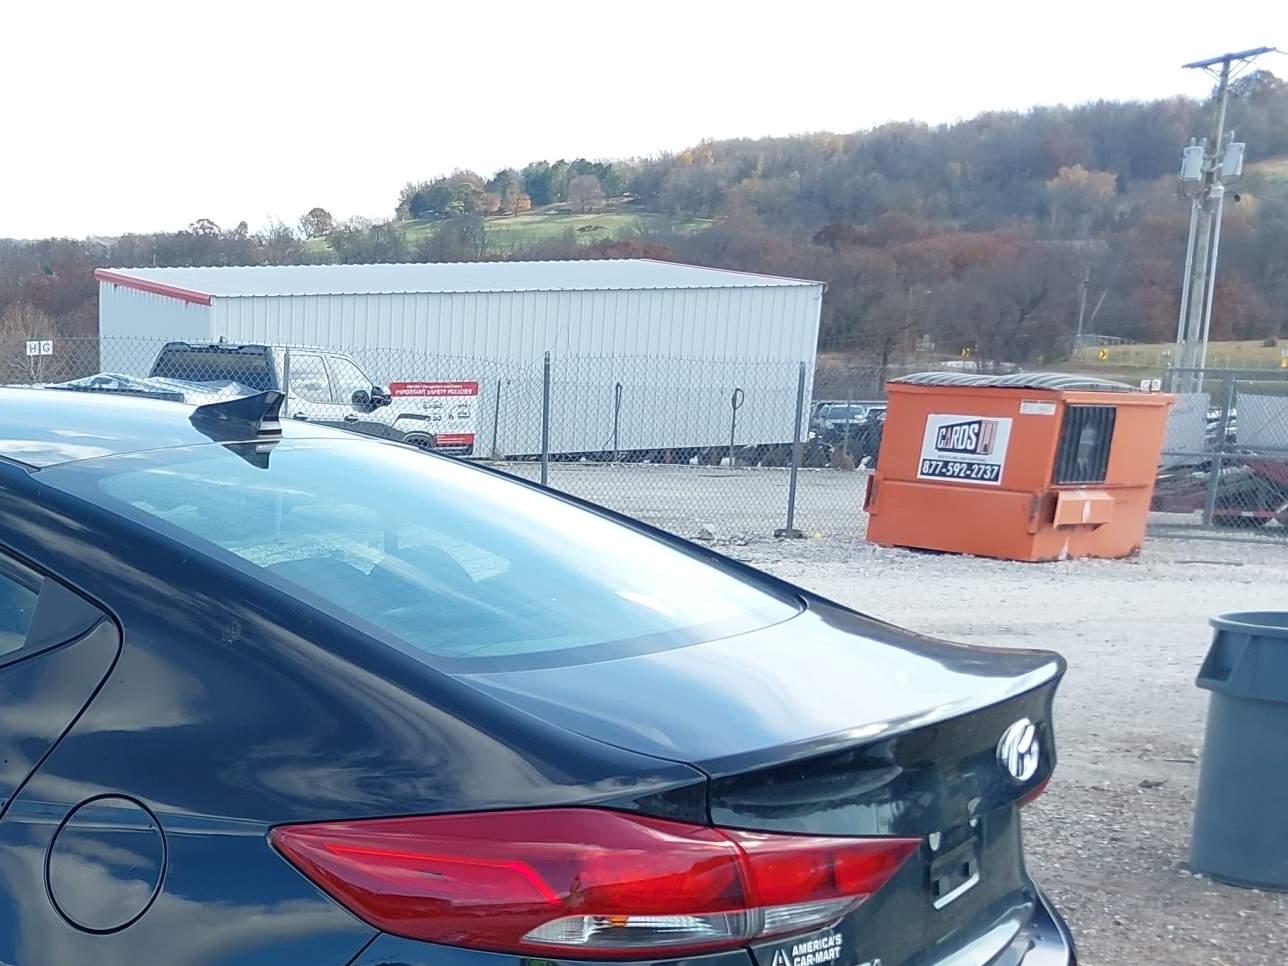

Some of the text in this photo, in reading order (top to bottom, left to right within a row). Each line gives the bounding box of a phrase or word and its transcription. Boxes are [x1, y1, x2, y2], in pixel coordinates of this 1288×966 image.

[936, 423, 980, 450] CARDS
[922, 460, 999, 480] 877-592-2737
[792, 933, 843, 957] AMERICA'S
